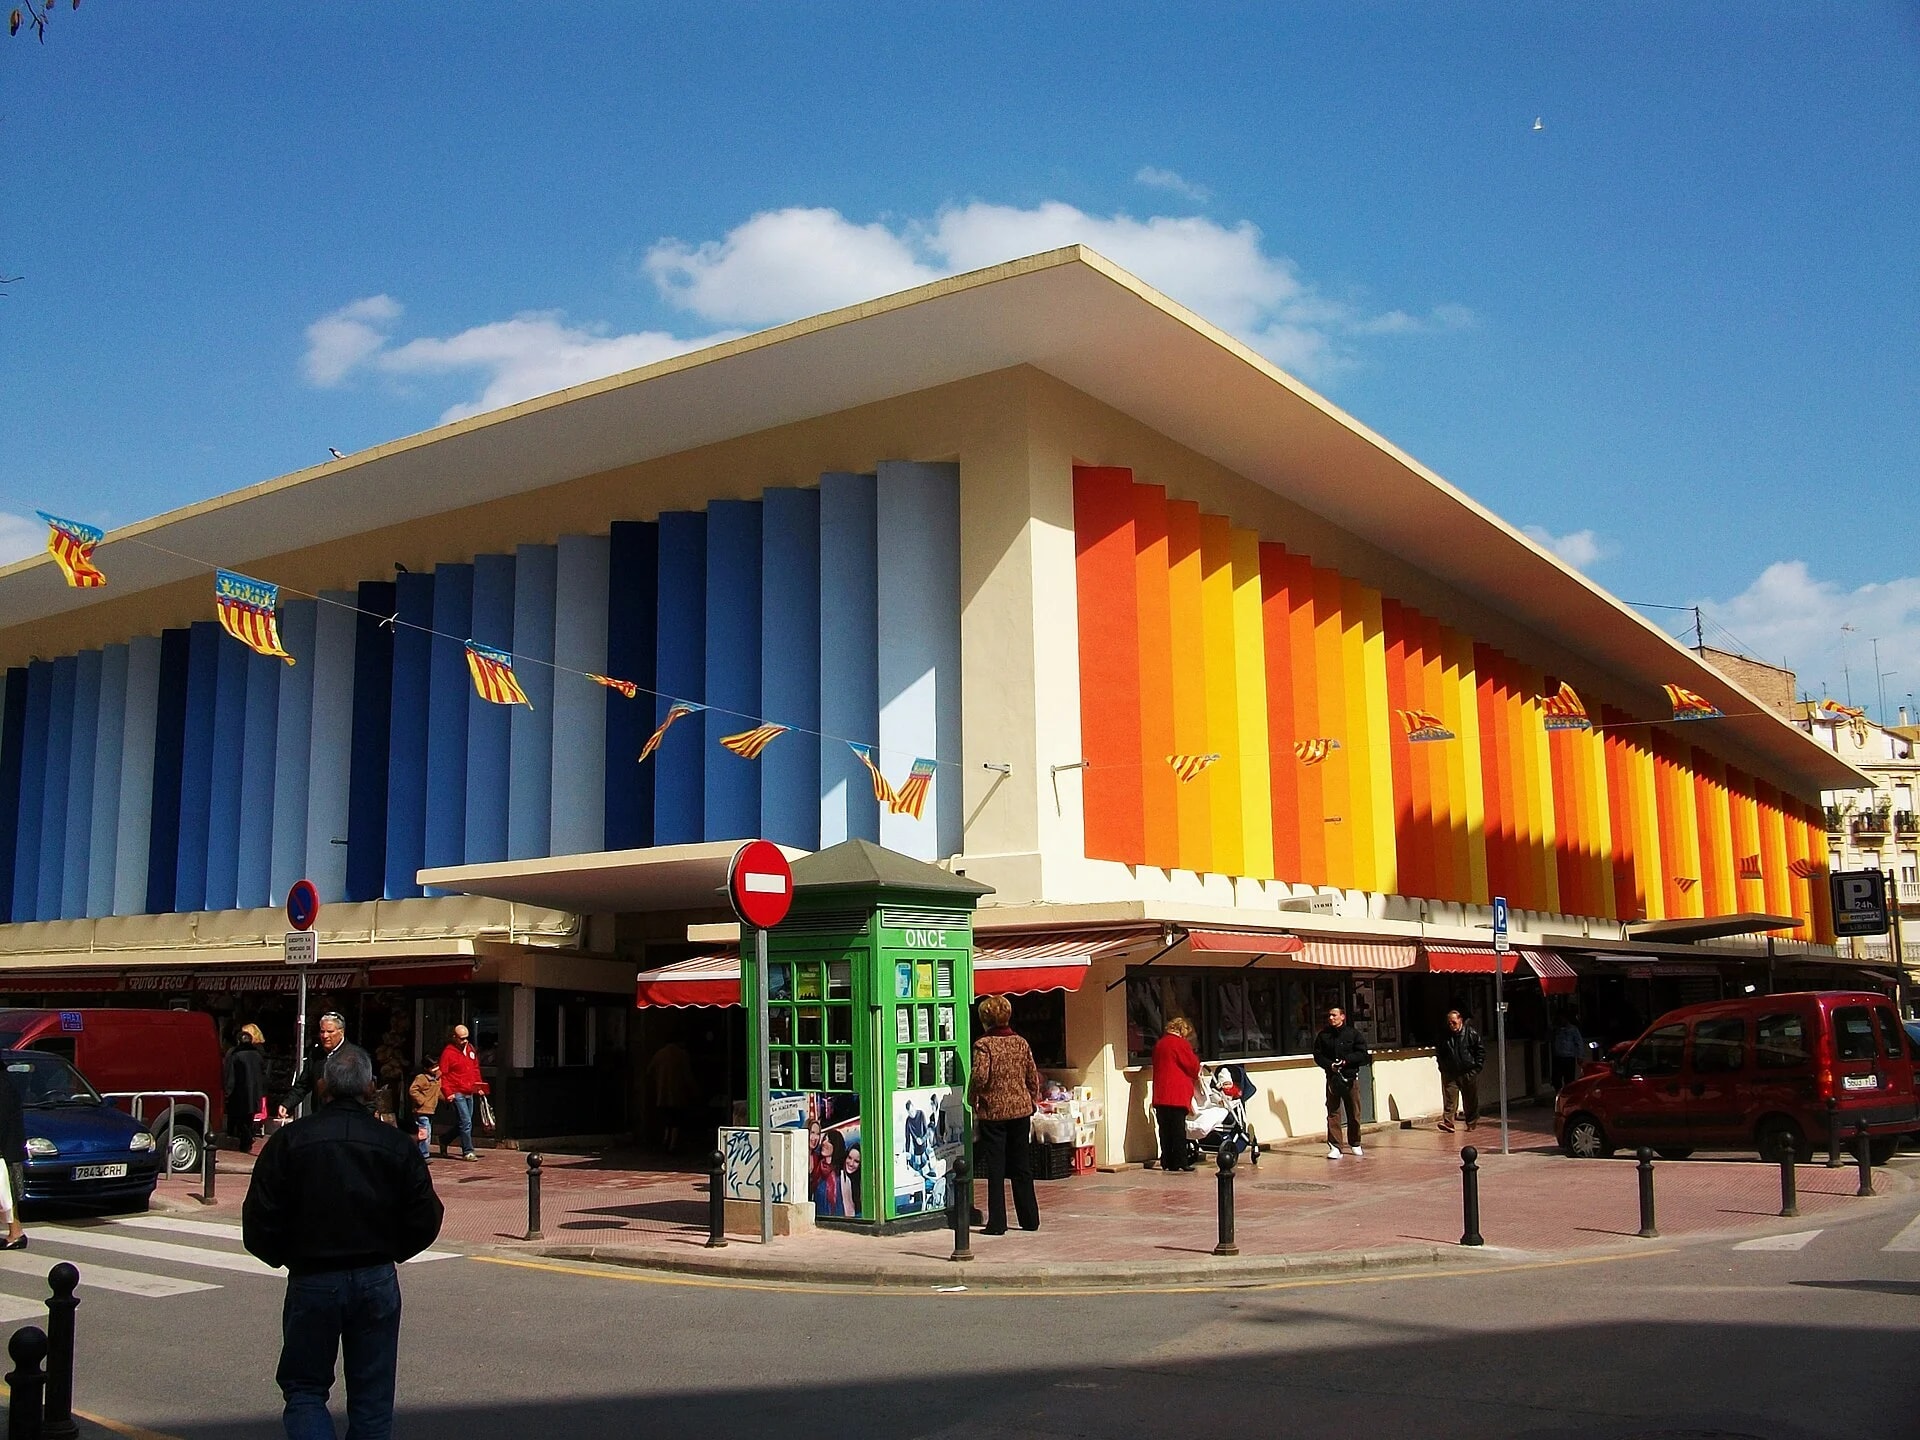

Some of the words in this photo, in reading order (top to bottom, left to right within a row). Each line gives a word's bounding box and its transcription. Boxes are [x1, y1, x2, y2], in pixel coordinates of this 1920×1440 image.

[1843, 880, 1872, 910] P
[1497, 905, 1504, 928] P
[905, 929, 947, 947] ONCE
[229, 975, 273, 991] CARAMELOS
[318, 973, 352, 989] SNACKS
